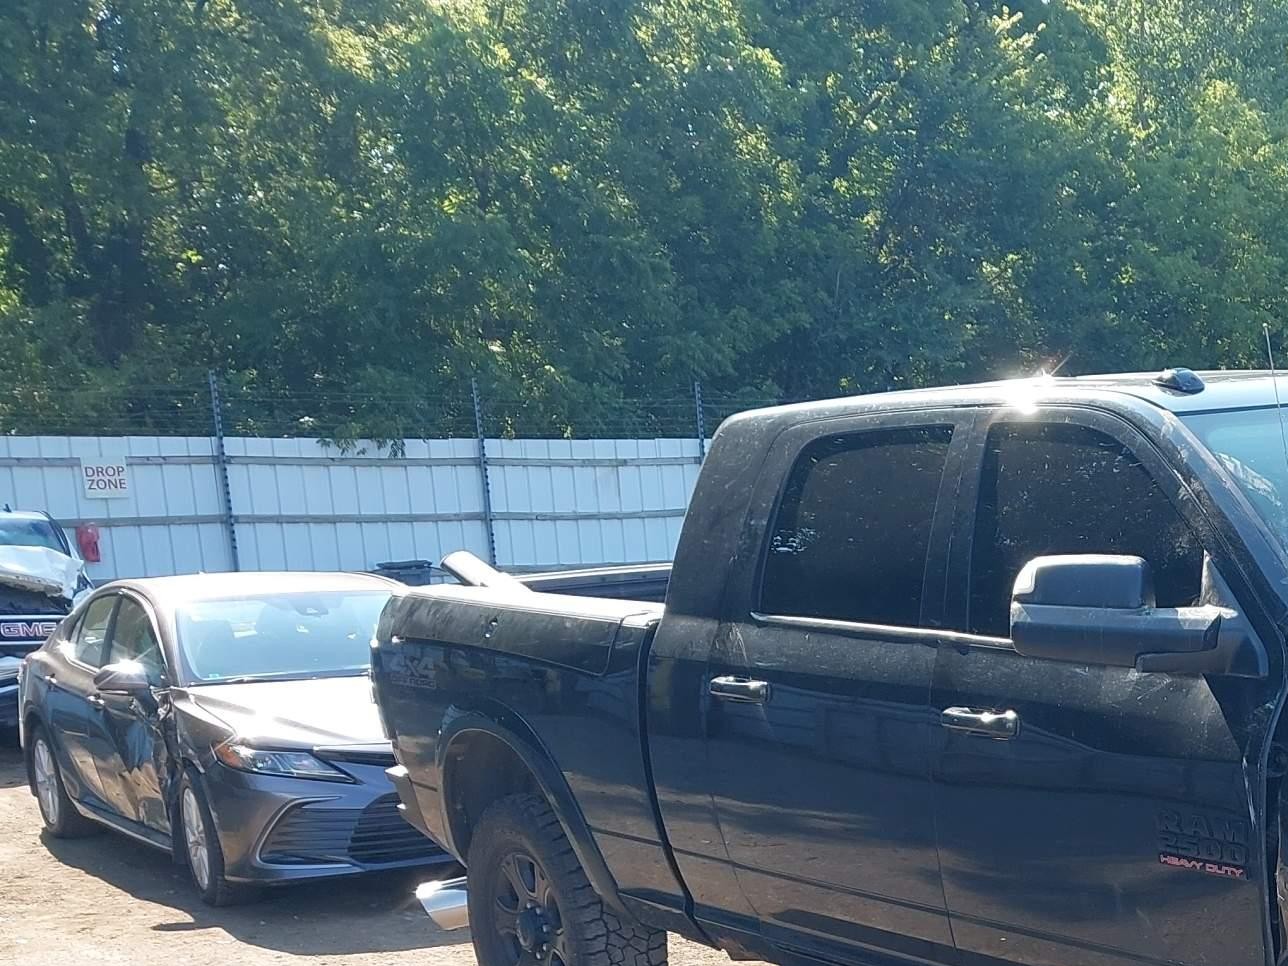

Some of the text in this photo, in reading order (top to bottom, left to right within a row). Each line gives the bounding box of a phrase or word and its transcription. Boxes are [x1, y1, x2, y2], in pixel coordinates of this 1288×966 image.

[84, 465, 125, 478] DROP
[87, 478, 127, 490] ZONE
[0, 622, 57, 637] GMC
[1160, 854, 1244, 878] HEAVY DUTY
